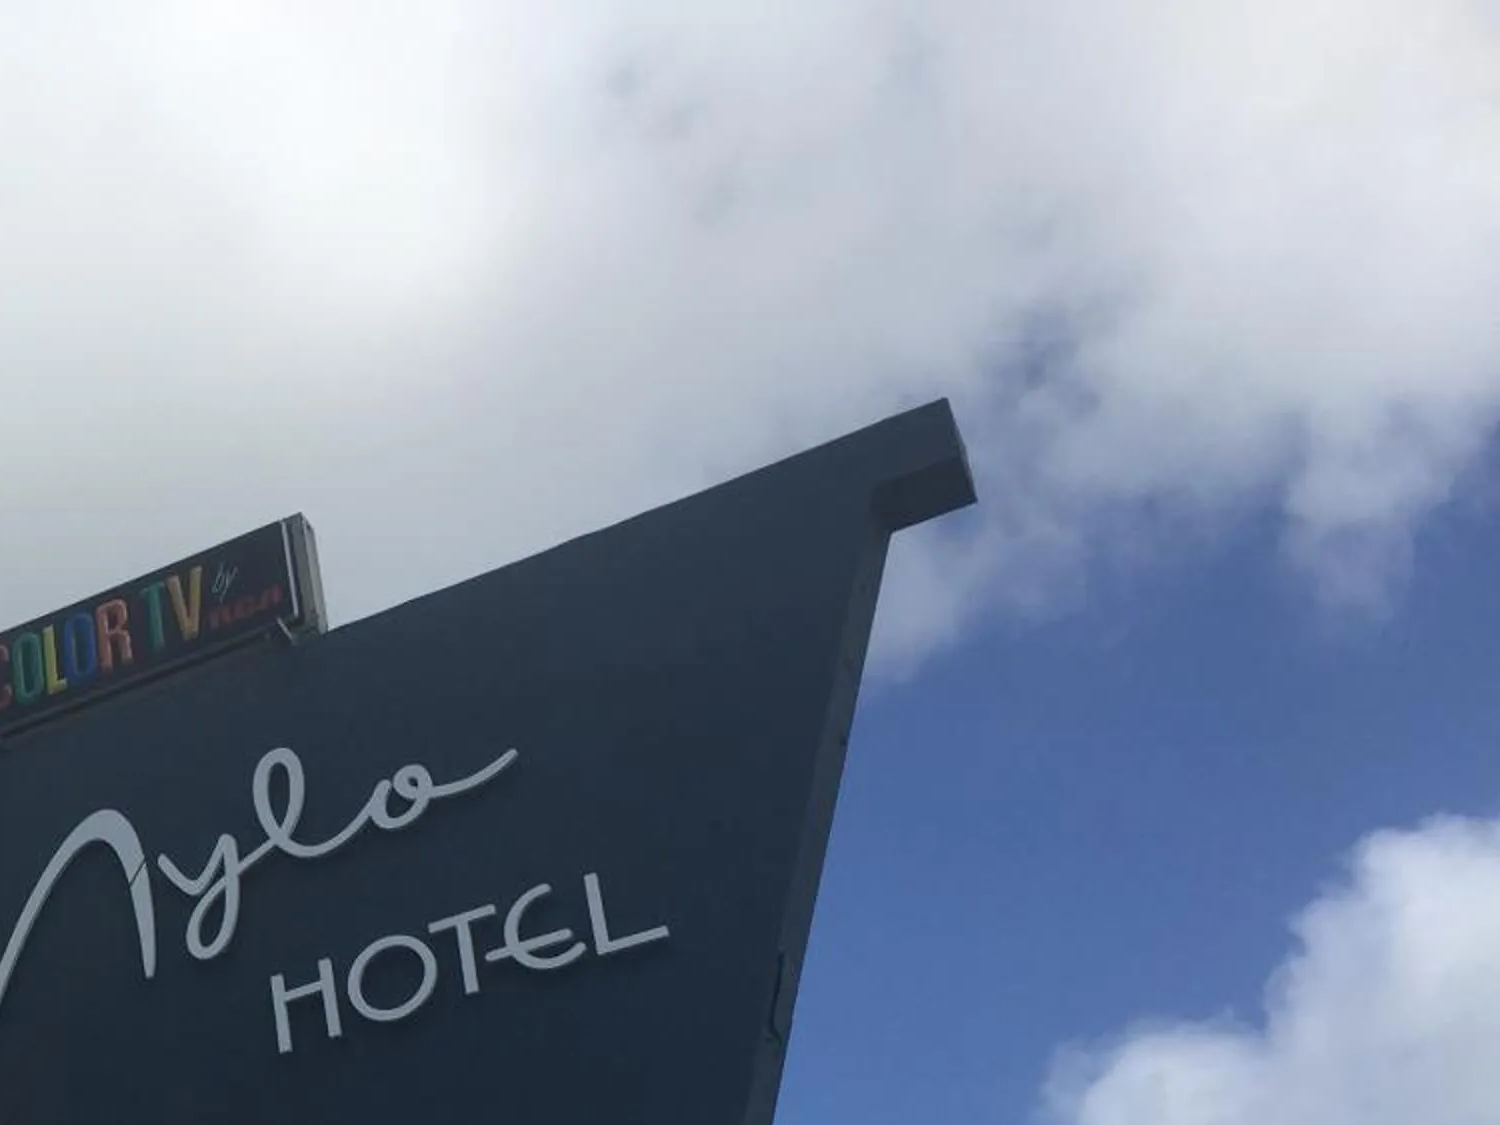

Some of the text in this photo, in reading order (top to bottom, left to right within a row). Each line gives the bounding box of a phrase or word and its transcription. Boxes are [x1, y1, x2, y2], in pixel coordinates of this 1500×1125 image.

[142, 565, 203, 652] TV
[211, 562, 238, 603] by
[269, 873, 670, 1053] HOTEL
